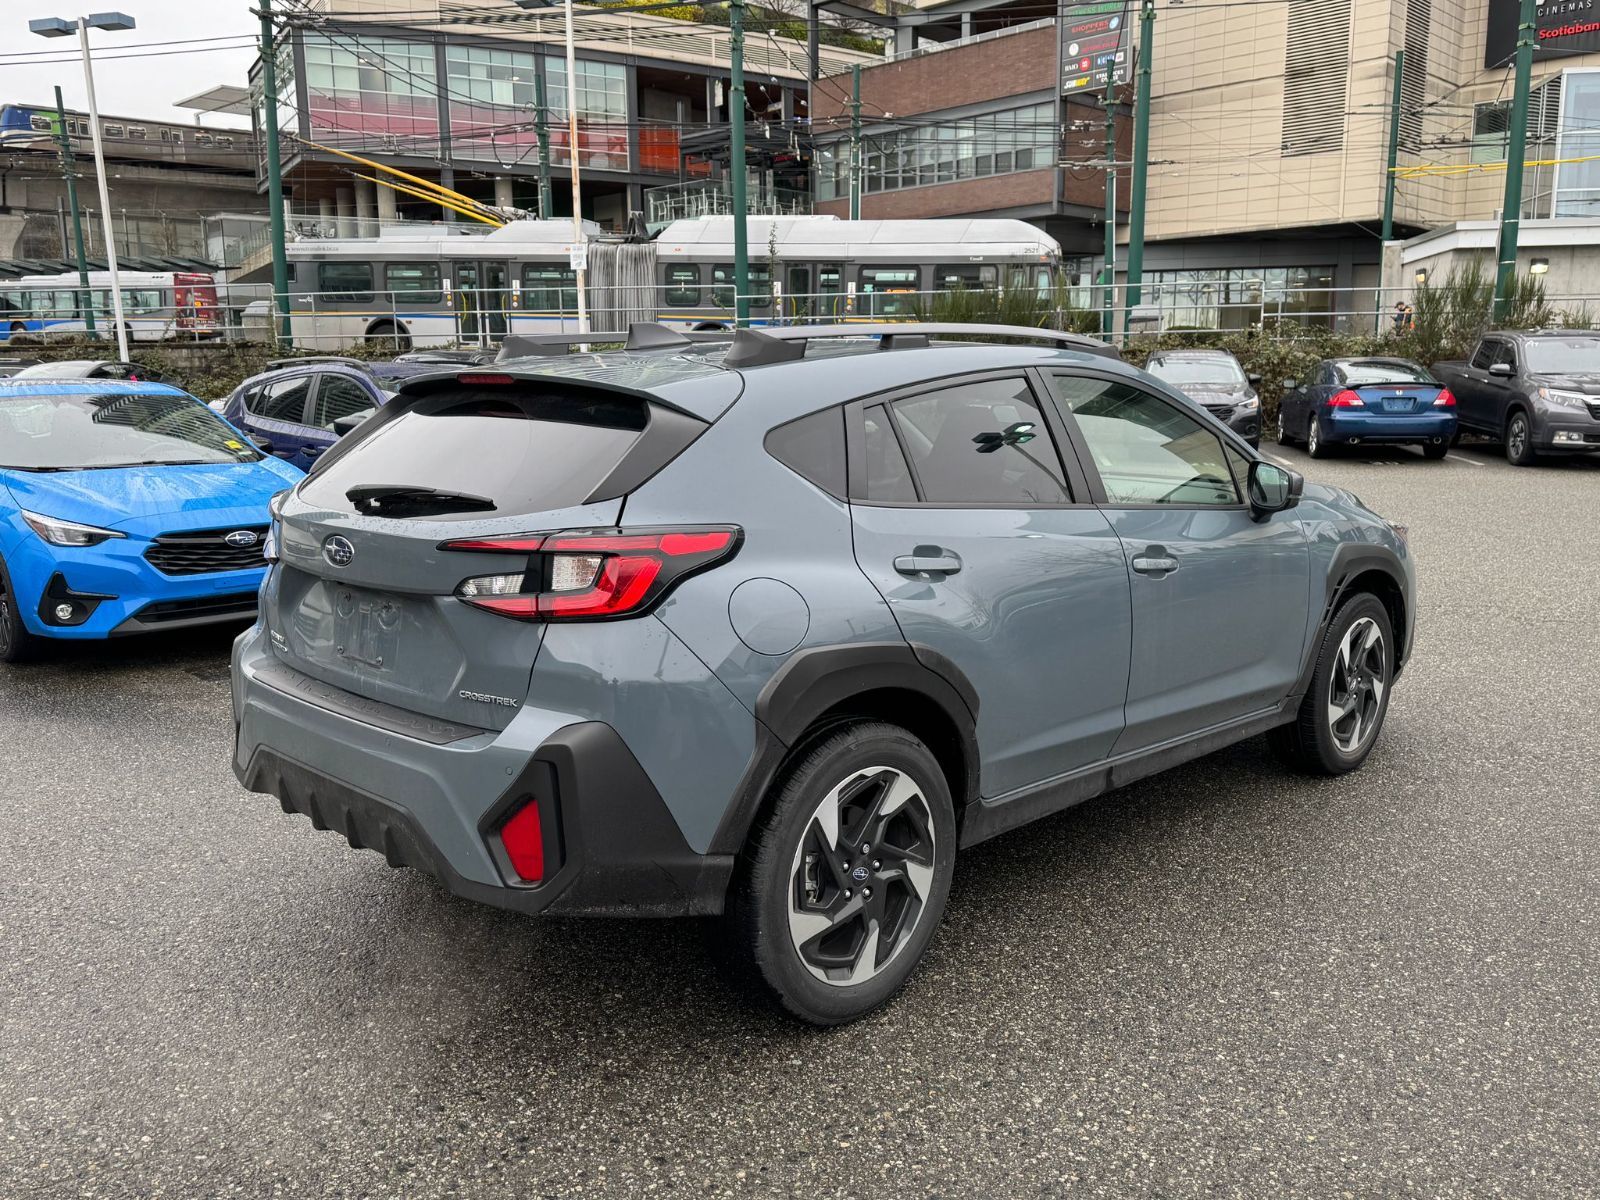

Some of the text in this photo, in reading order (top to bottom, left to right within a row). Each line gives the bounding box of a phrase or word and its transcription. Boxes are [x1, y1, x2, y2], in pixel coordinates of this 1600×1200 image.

[1537, 0, 1592, 16] CINEMAS
[1072, 20, 1109, 33] SHOPPERS
[1539, 22, 1600, 39] Scotiaban
[1064, 63, 1079, 72] BMO
[459, 690, 518, 707] CROSSTREK
